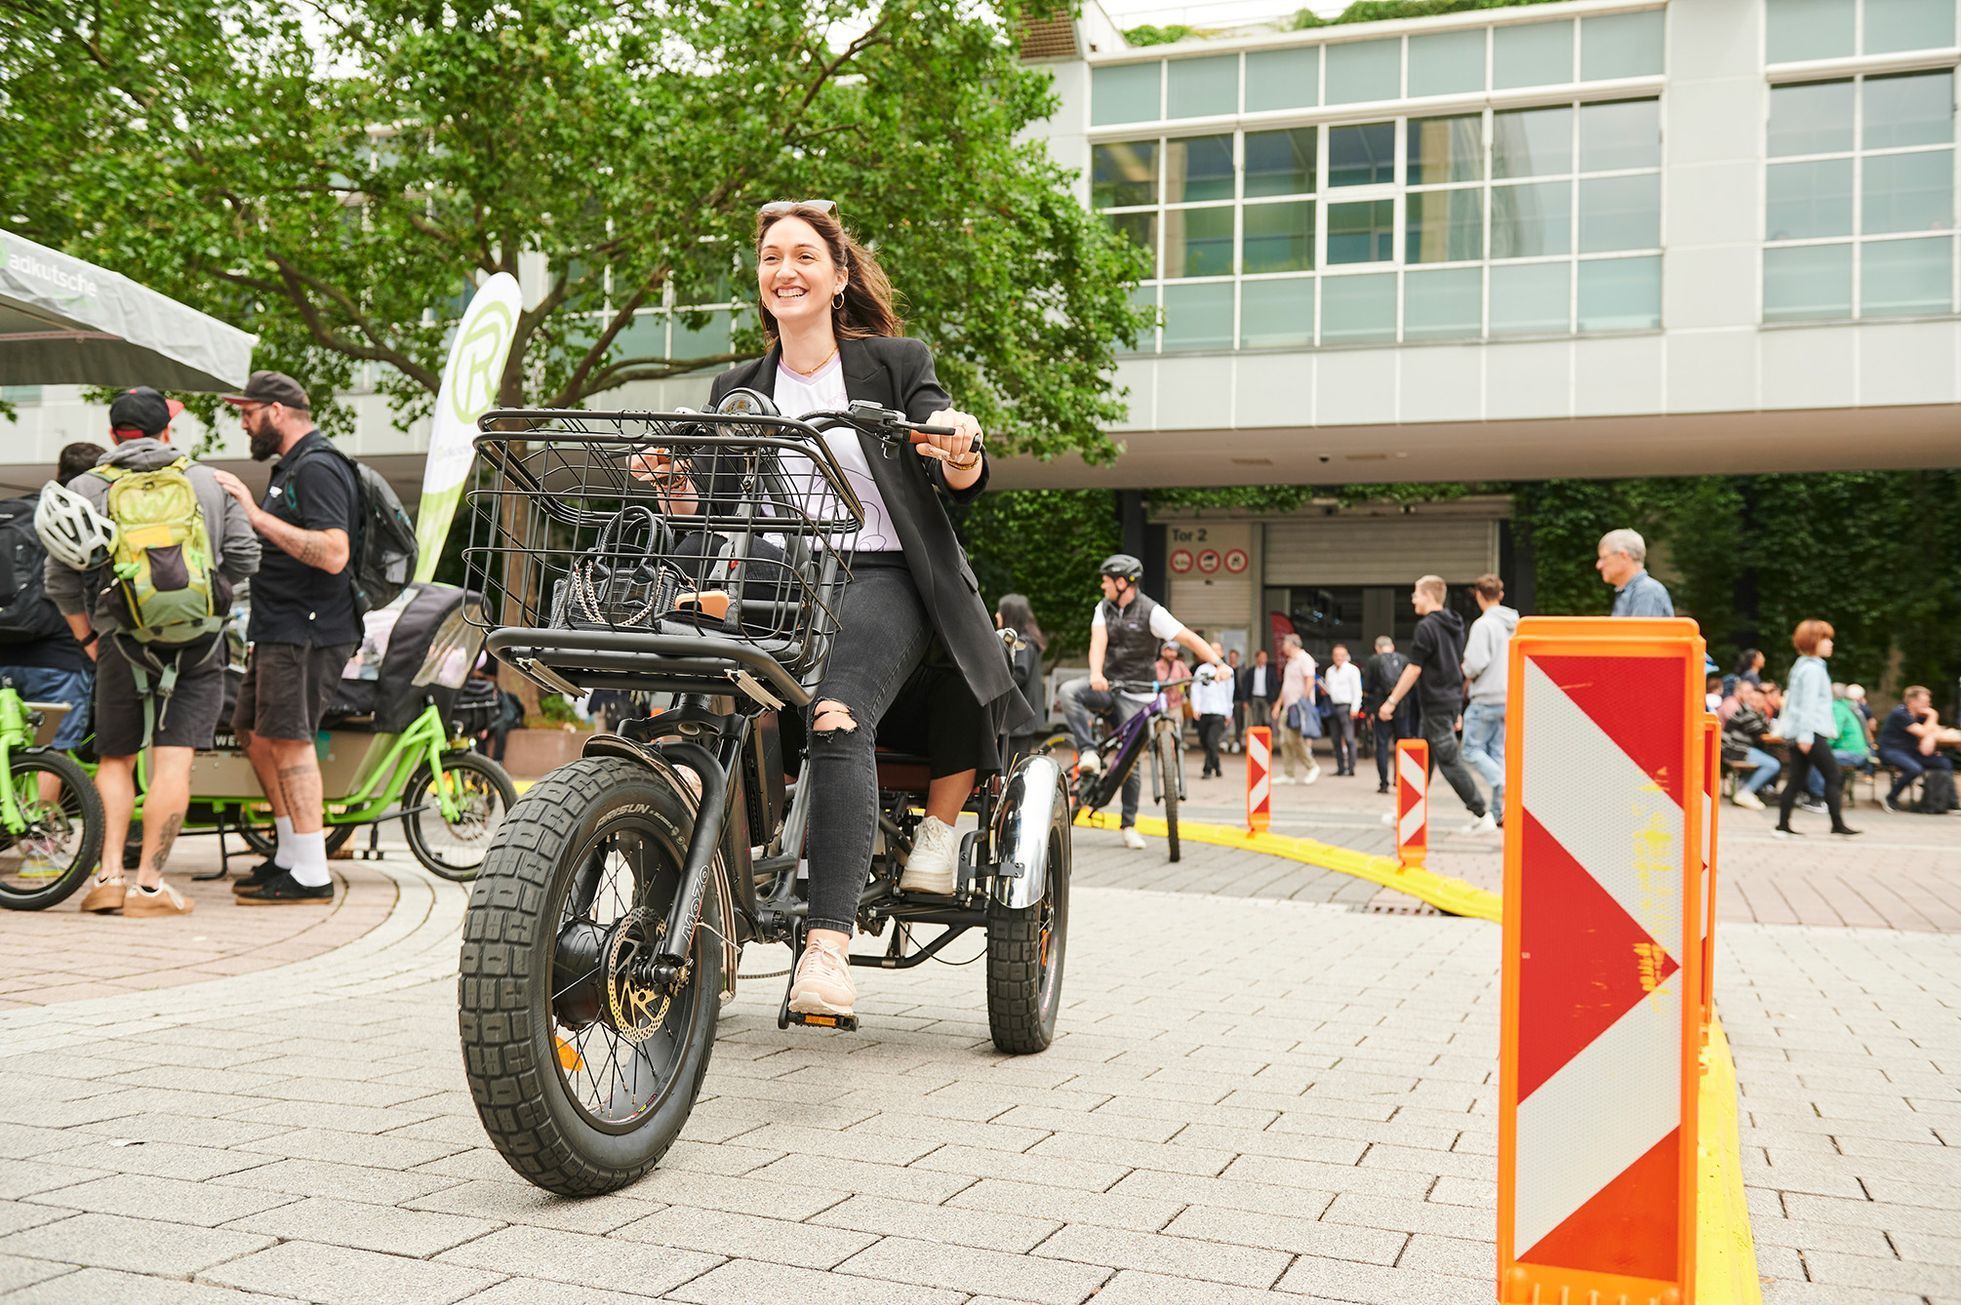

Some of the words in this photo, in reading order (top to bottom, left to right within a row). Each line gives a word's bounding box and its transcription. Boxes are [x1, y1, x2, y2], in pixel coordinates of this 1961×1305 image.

[1172, 528, 1193, 542] Tor
[1197, 528, 1208, 542] 2
[681, 865, 710, 945] MOZO
